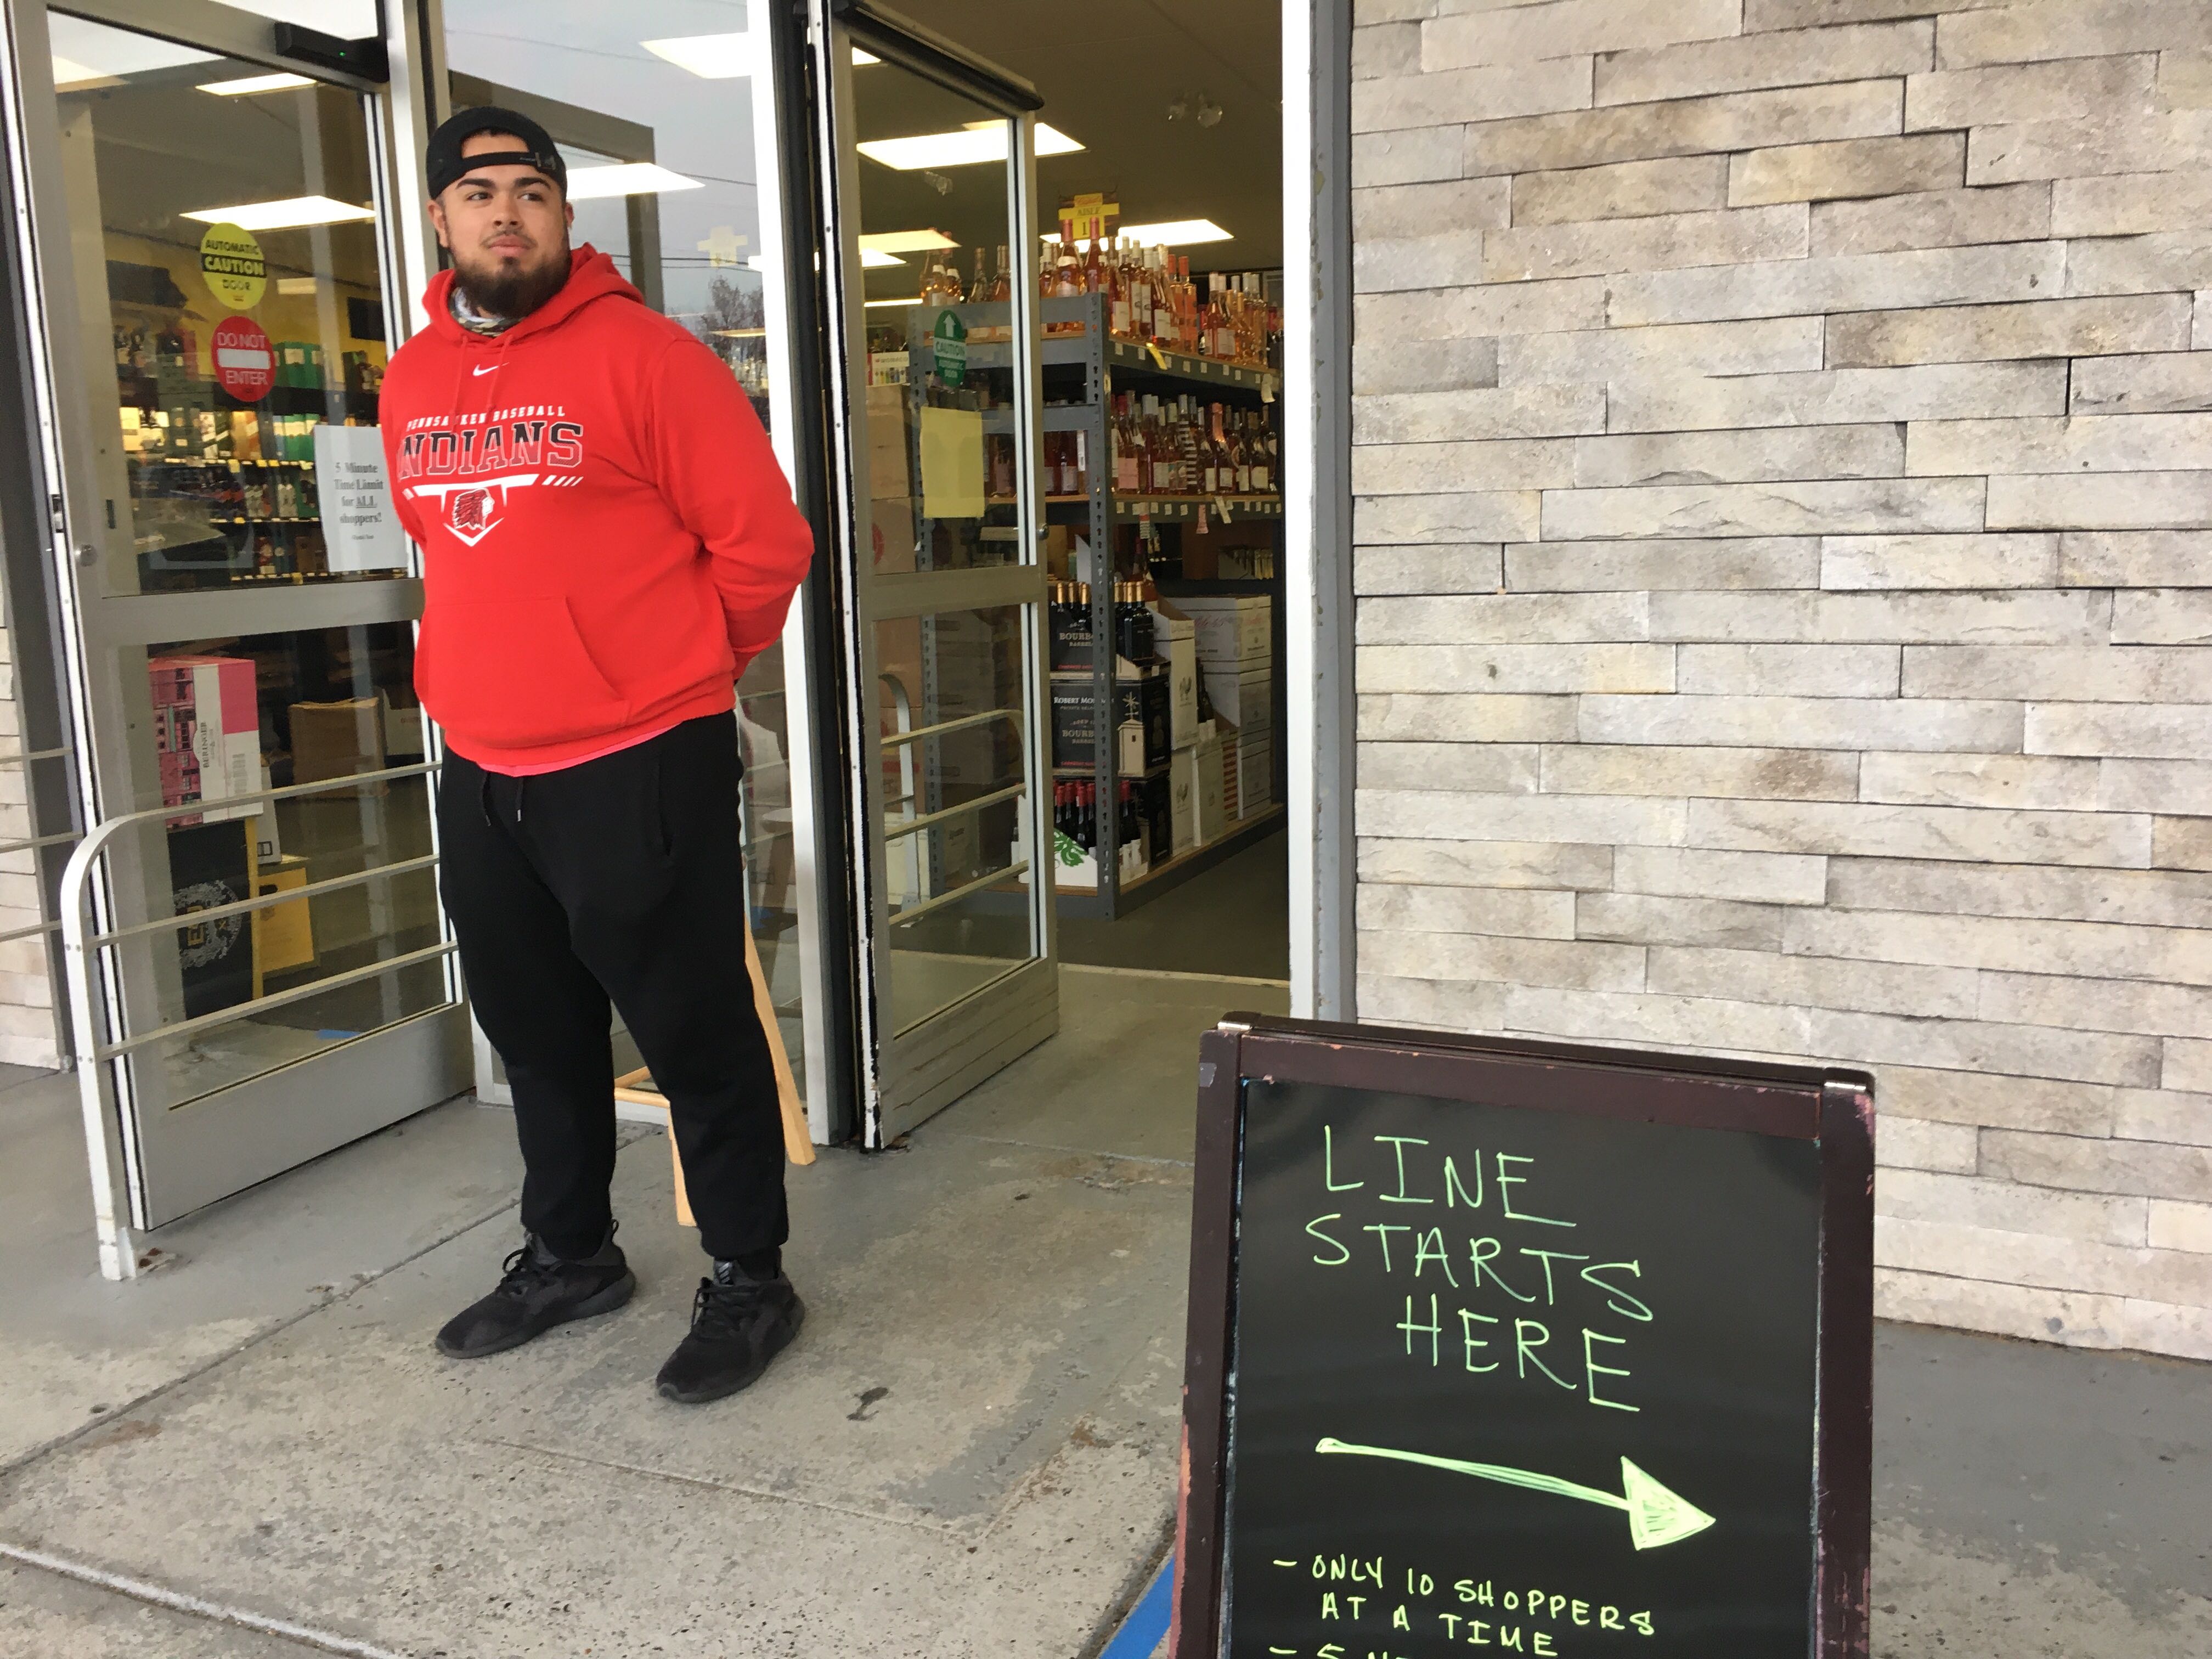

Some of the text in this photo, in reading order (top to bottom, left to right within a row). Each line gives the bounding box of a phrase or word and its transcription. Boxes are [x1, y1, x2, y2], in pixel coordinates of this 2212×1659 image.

[1082, 222, 1087, 236] 1
[205, 240, 259, 255] AUTOMATIC
[204, 256, 264, 275] CAUTION
[222, 279, 251, 291] DOOR
[217, 332, 266, 348] DO NOT
[225, 370, 268, 385] ENTER
[406, 405, 566, 432] PENNSAKEN BASEBALL
[396, 420, 583, 483] NDIANS
[335, 461, 379, 473] 5 Minute
[334, 478, 384, 490] Time Limit
[341, 495, 378, 507] for ALL
[338, 512, 382, 526] shoppers!
[1059, 632, 1093, 640] BOURB
[200, 721, 210, 769] BERINGER
[1323, 1124, 1577, 1228] LINE
[1305, 1212, 1654, 1322] STARTS
[1396, 1292, 1640, 1413] HERE
[1312, 1553, 1383, 1589] ONLY
[1408, 1567, 1434, 1596] 10
[1453, 1579, 1655, 1636] SHOPPERS
[1322, 1592, 1558, 1657] AT A TIME
